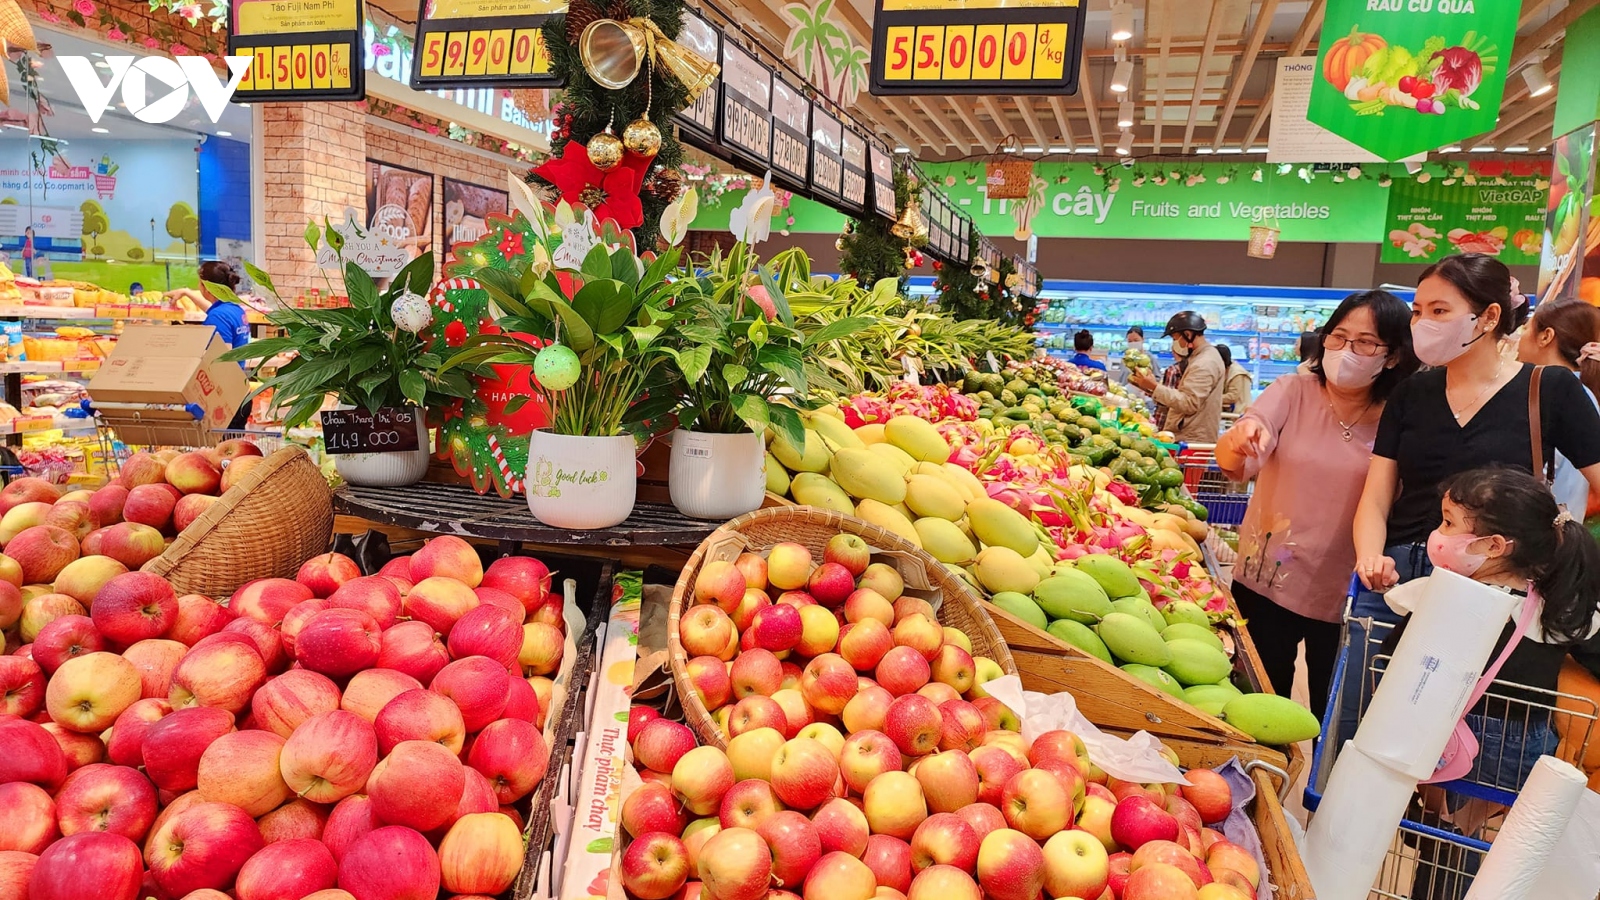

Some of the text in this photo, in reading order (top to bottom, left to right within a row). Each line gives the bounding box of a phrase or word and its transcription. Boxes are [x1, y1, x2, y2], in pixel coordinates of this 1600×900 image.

[303, 2, 321, 10] Nam
[426, 35, 531, 69] 59.900
[891, 32, 1027, 70] 55.000
[1284, 63, 1313, 72] THÔNG
[1052, 186, 1116, 224] cây
[1131, 200, 1180, 217] Fruits
[1188, 202, 1221, 218] and
[1229, 202, 1330, 222] Vegetables
[1479, 190, 1543, 203] VietGAP
[396, 412, 411, 423] 05
[327, 431, 400, 450] 149.000
[579, 470, 598, 485] luck
[583, 798, 609, 832] chay
